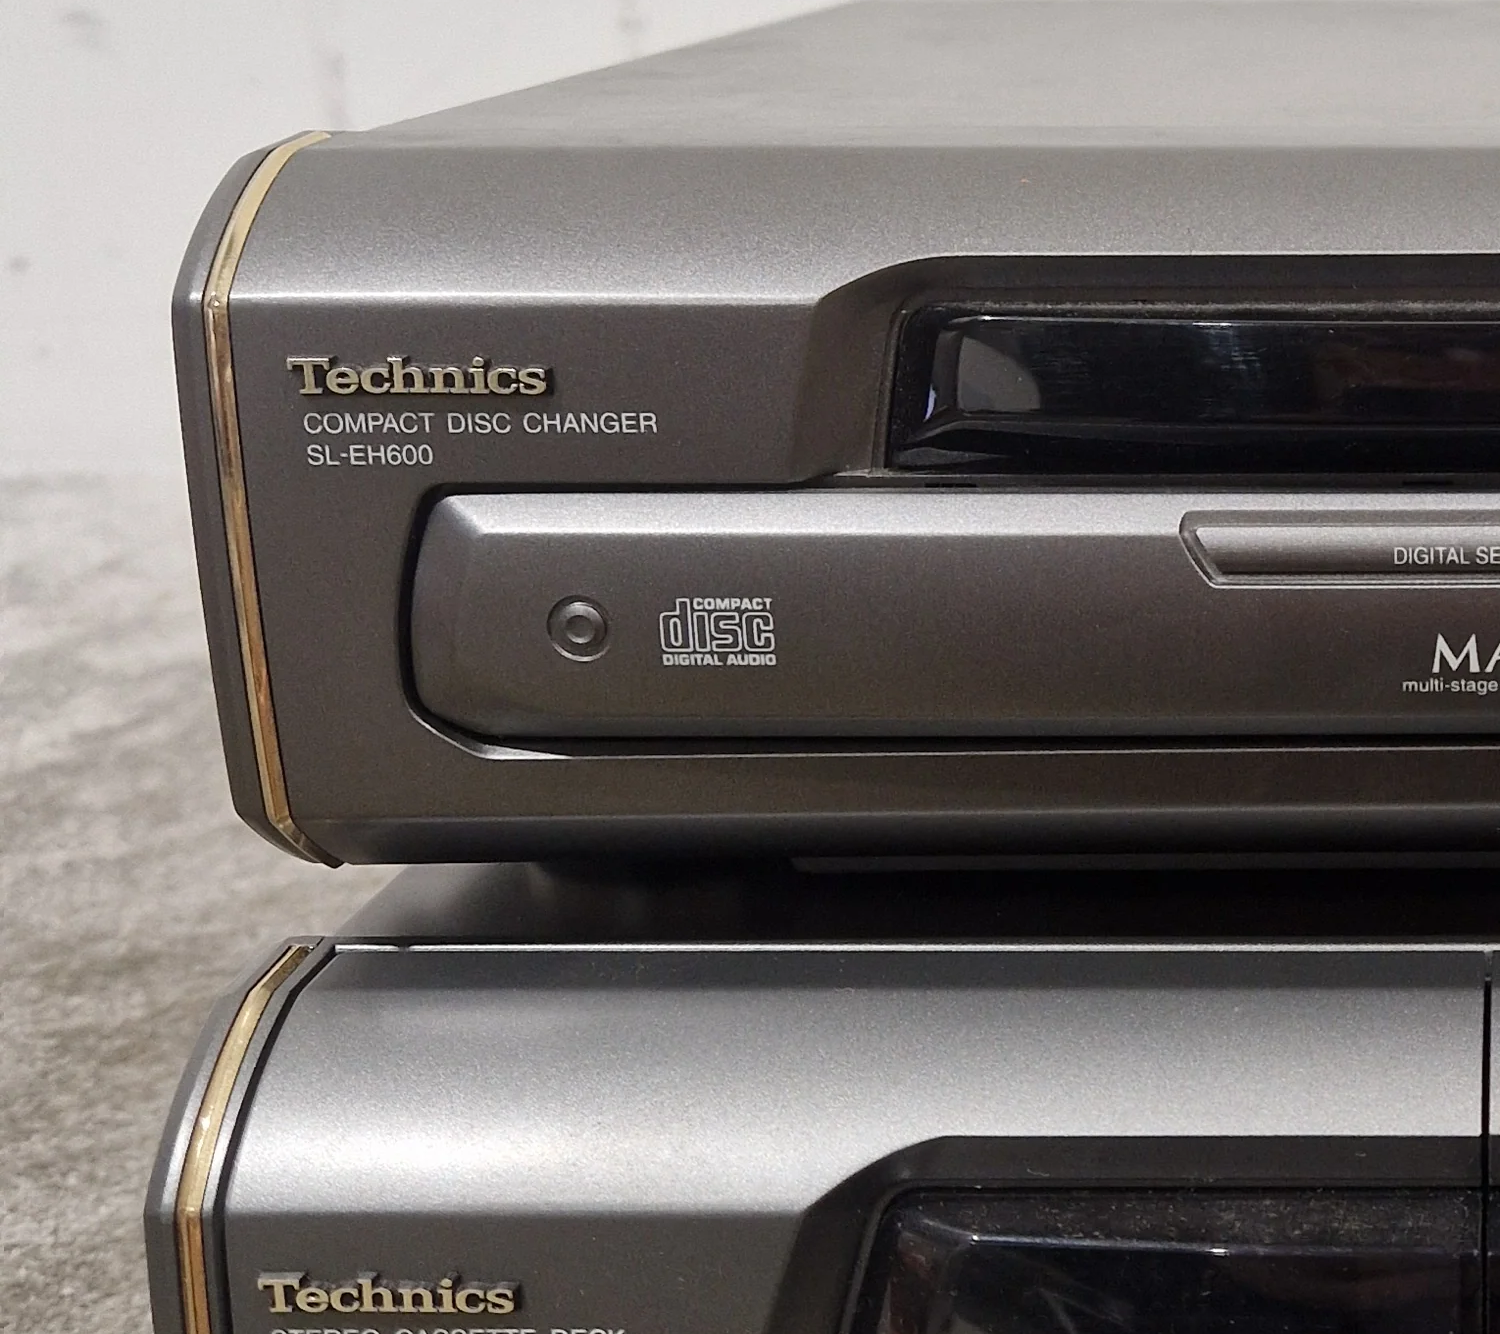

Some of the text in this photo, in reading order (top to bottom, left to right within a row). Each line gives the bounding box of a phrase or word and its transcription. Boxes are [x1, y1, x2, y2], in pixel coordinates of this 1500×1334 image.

[286, 354, 549, 397] Technics
[302, 411, 658, 435] COMPACT DISC CHANGER
[306, 443, 433, 467] SL-EH600
[1393, 546, 1470, 565] DIGITAL
[692, 597, 773, 611] COMPACT
[659, 597, 776, 652] disc
[662, 653, 777, 666] DIGITAL AUDIO
[1402, 677, 1499, 695] multi-stage
[257, 1273, 517, 1314] Technics
